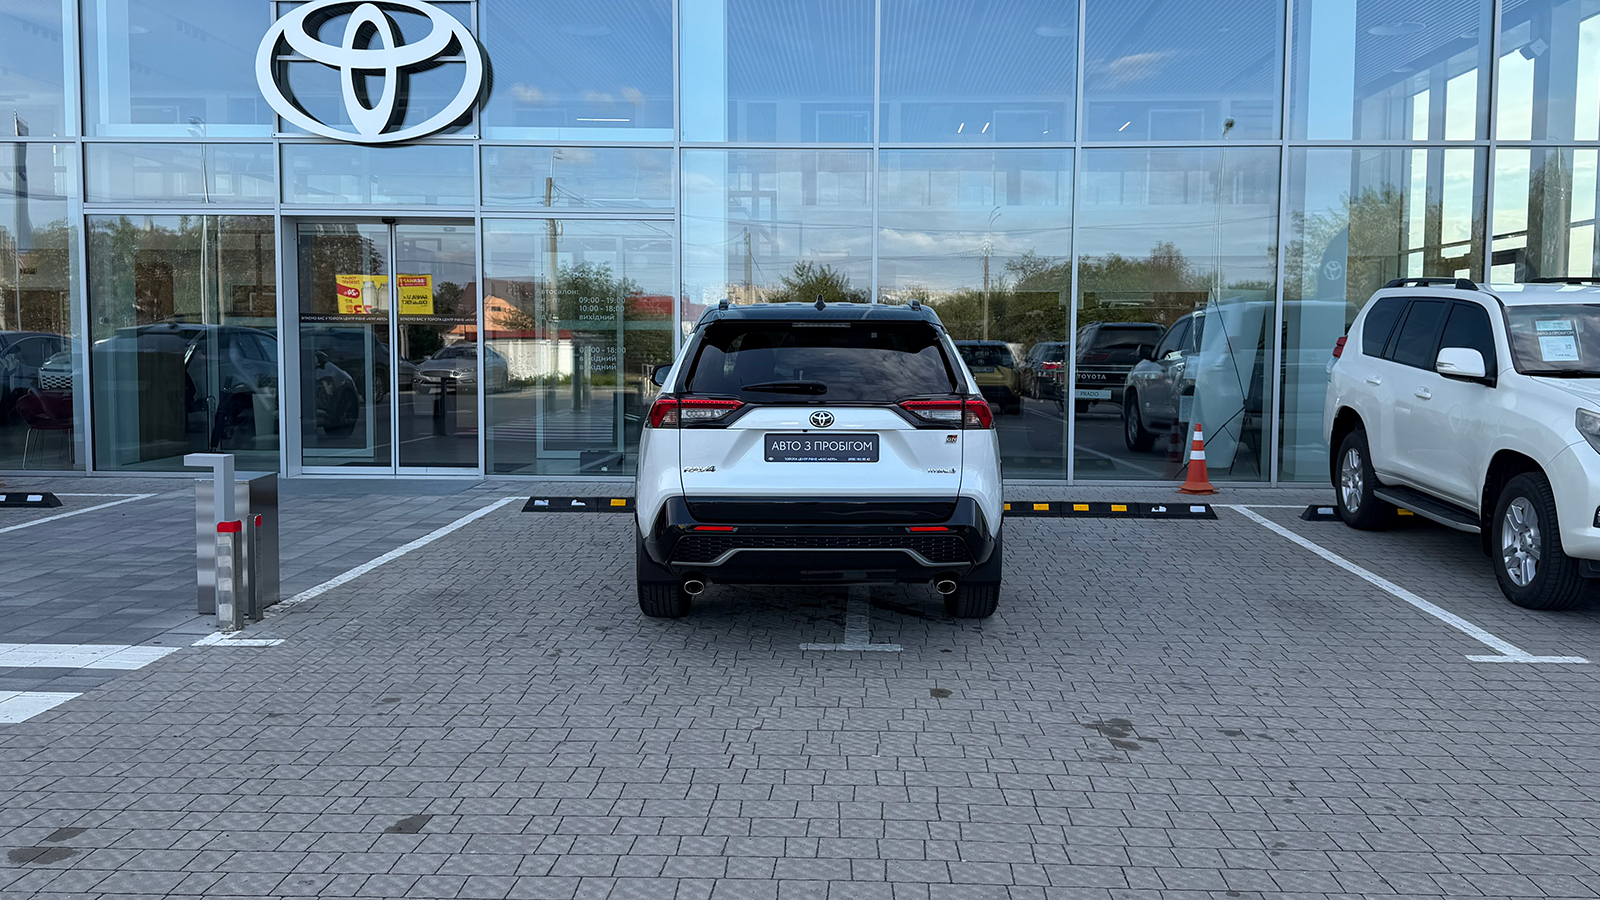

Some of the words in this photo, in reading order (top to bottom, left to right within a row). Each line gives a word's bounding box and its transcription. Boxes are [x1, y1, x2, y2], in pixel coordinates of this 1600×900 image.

[579, 313, 615, 321] вихідний
[606, 346, 626, 354] 18:00
[771, 440, 802, 451] АВТО
[804, 440, 812, 451] З
[814, 440, 873, 451] ПРОБІГОМ
[683, 465, 716, 473] RAV4
